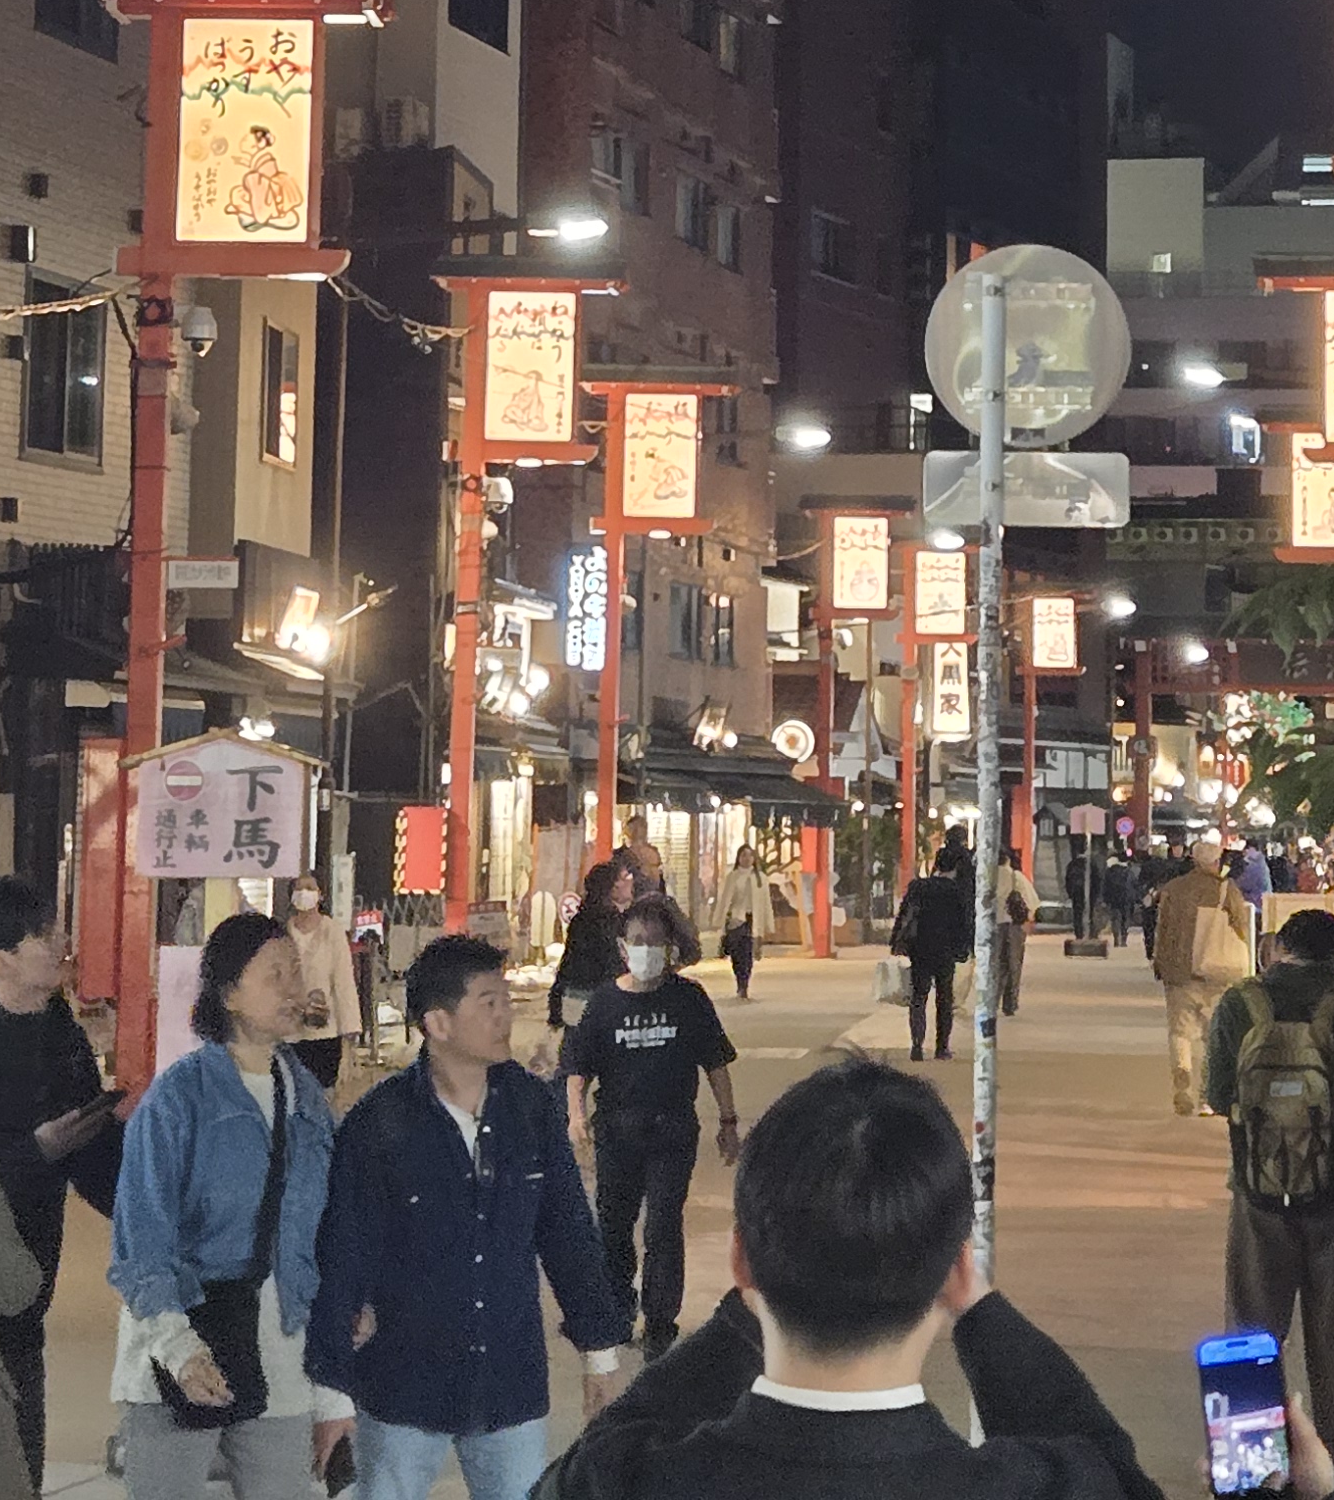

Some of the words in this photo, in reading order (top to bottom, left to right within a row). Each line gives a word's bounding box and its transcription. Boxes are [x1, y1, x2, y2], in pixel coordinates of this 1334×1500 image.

[153, 808, 178, 869] 通行止
[223, 765, 284, 869] 下馬
